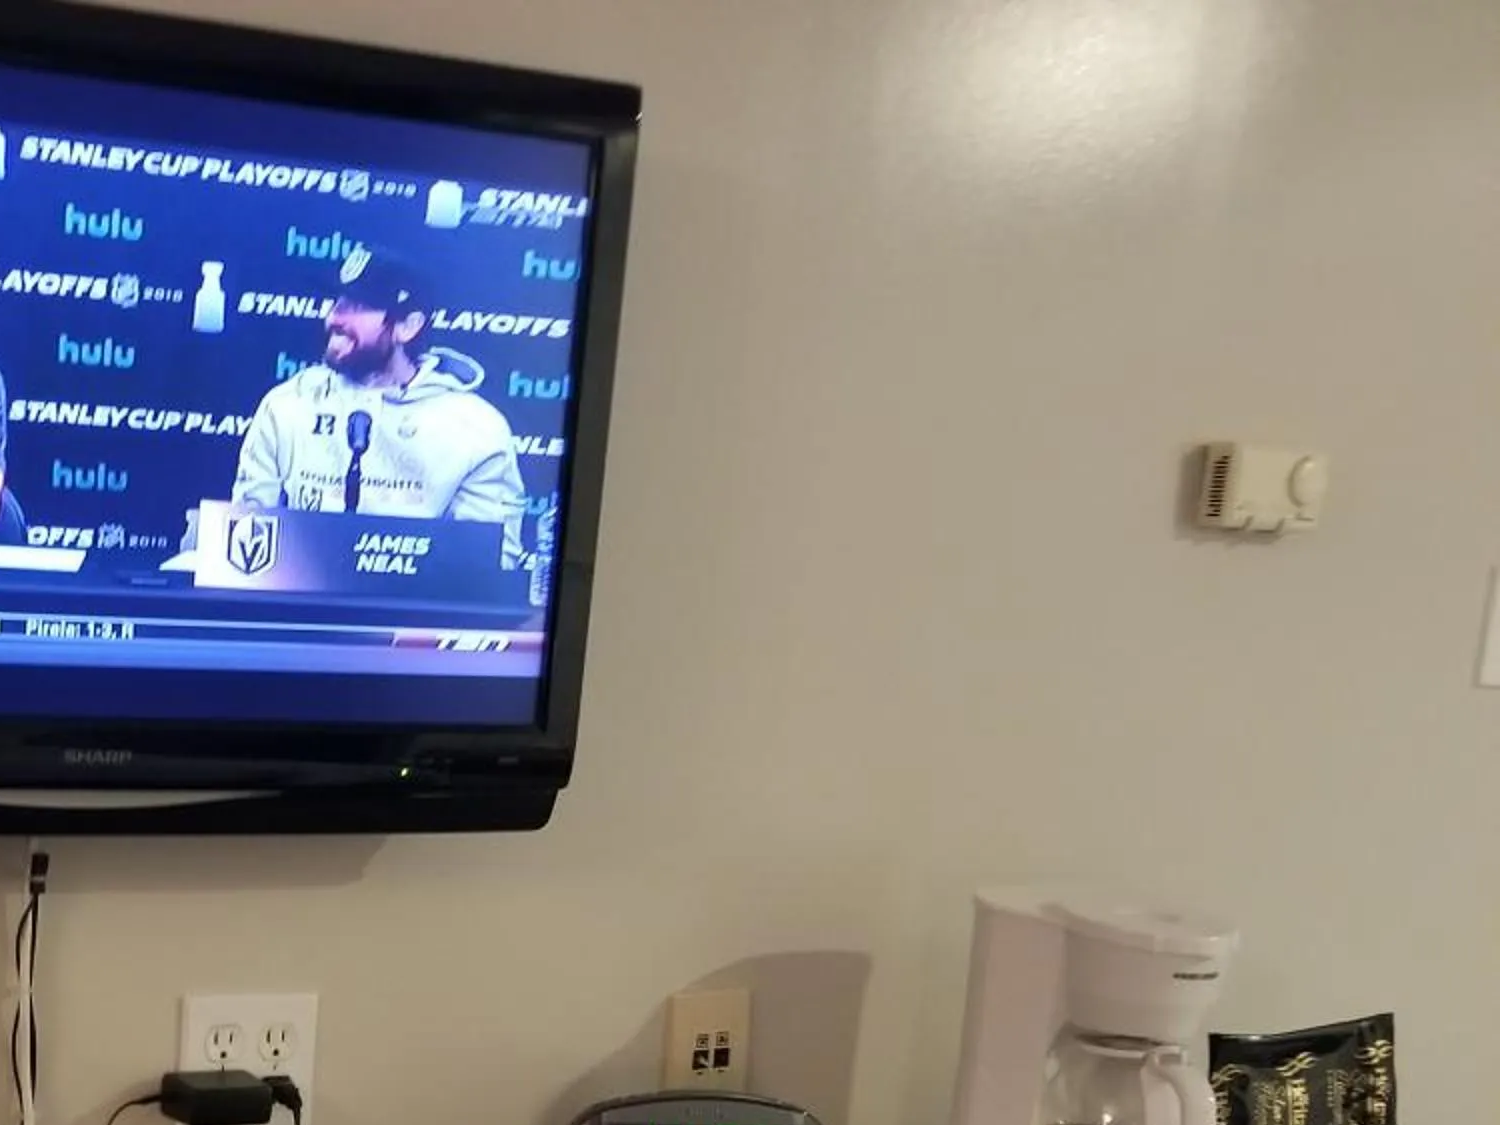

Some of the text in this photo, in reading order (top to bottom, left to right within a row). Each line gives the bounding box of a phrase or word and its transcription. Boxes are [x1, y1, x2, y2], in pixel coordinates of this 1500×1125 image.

[20, 136, 146, 172] STANLEY
[143, 151, 200, 178] CUP
[200, 158, 339, 194] PLAYOFFS
[64, 201, 144, 241] hulu
[522, 249, 581, 281] hu
[431, 308, 572, 338] LAYOFFS
[58, 332, 136, 369] hulu
[8, 399, 254, 437] STANLEY CUP PLAY
[52, 458, 129, 492] hulu
[26, 525, 95, 549] OFFS
[353, 532, 432, 556] JAMES
[355, 554, 418, 576] NEAL
[63, 748, 132, 765] SHARP
